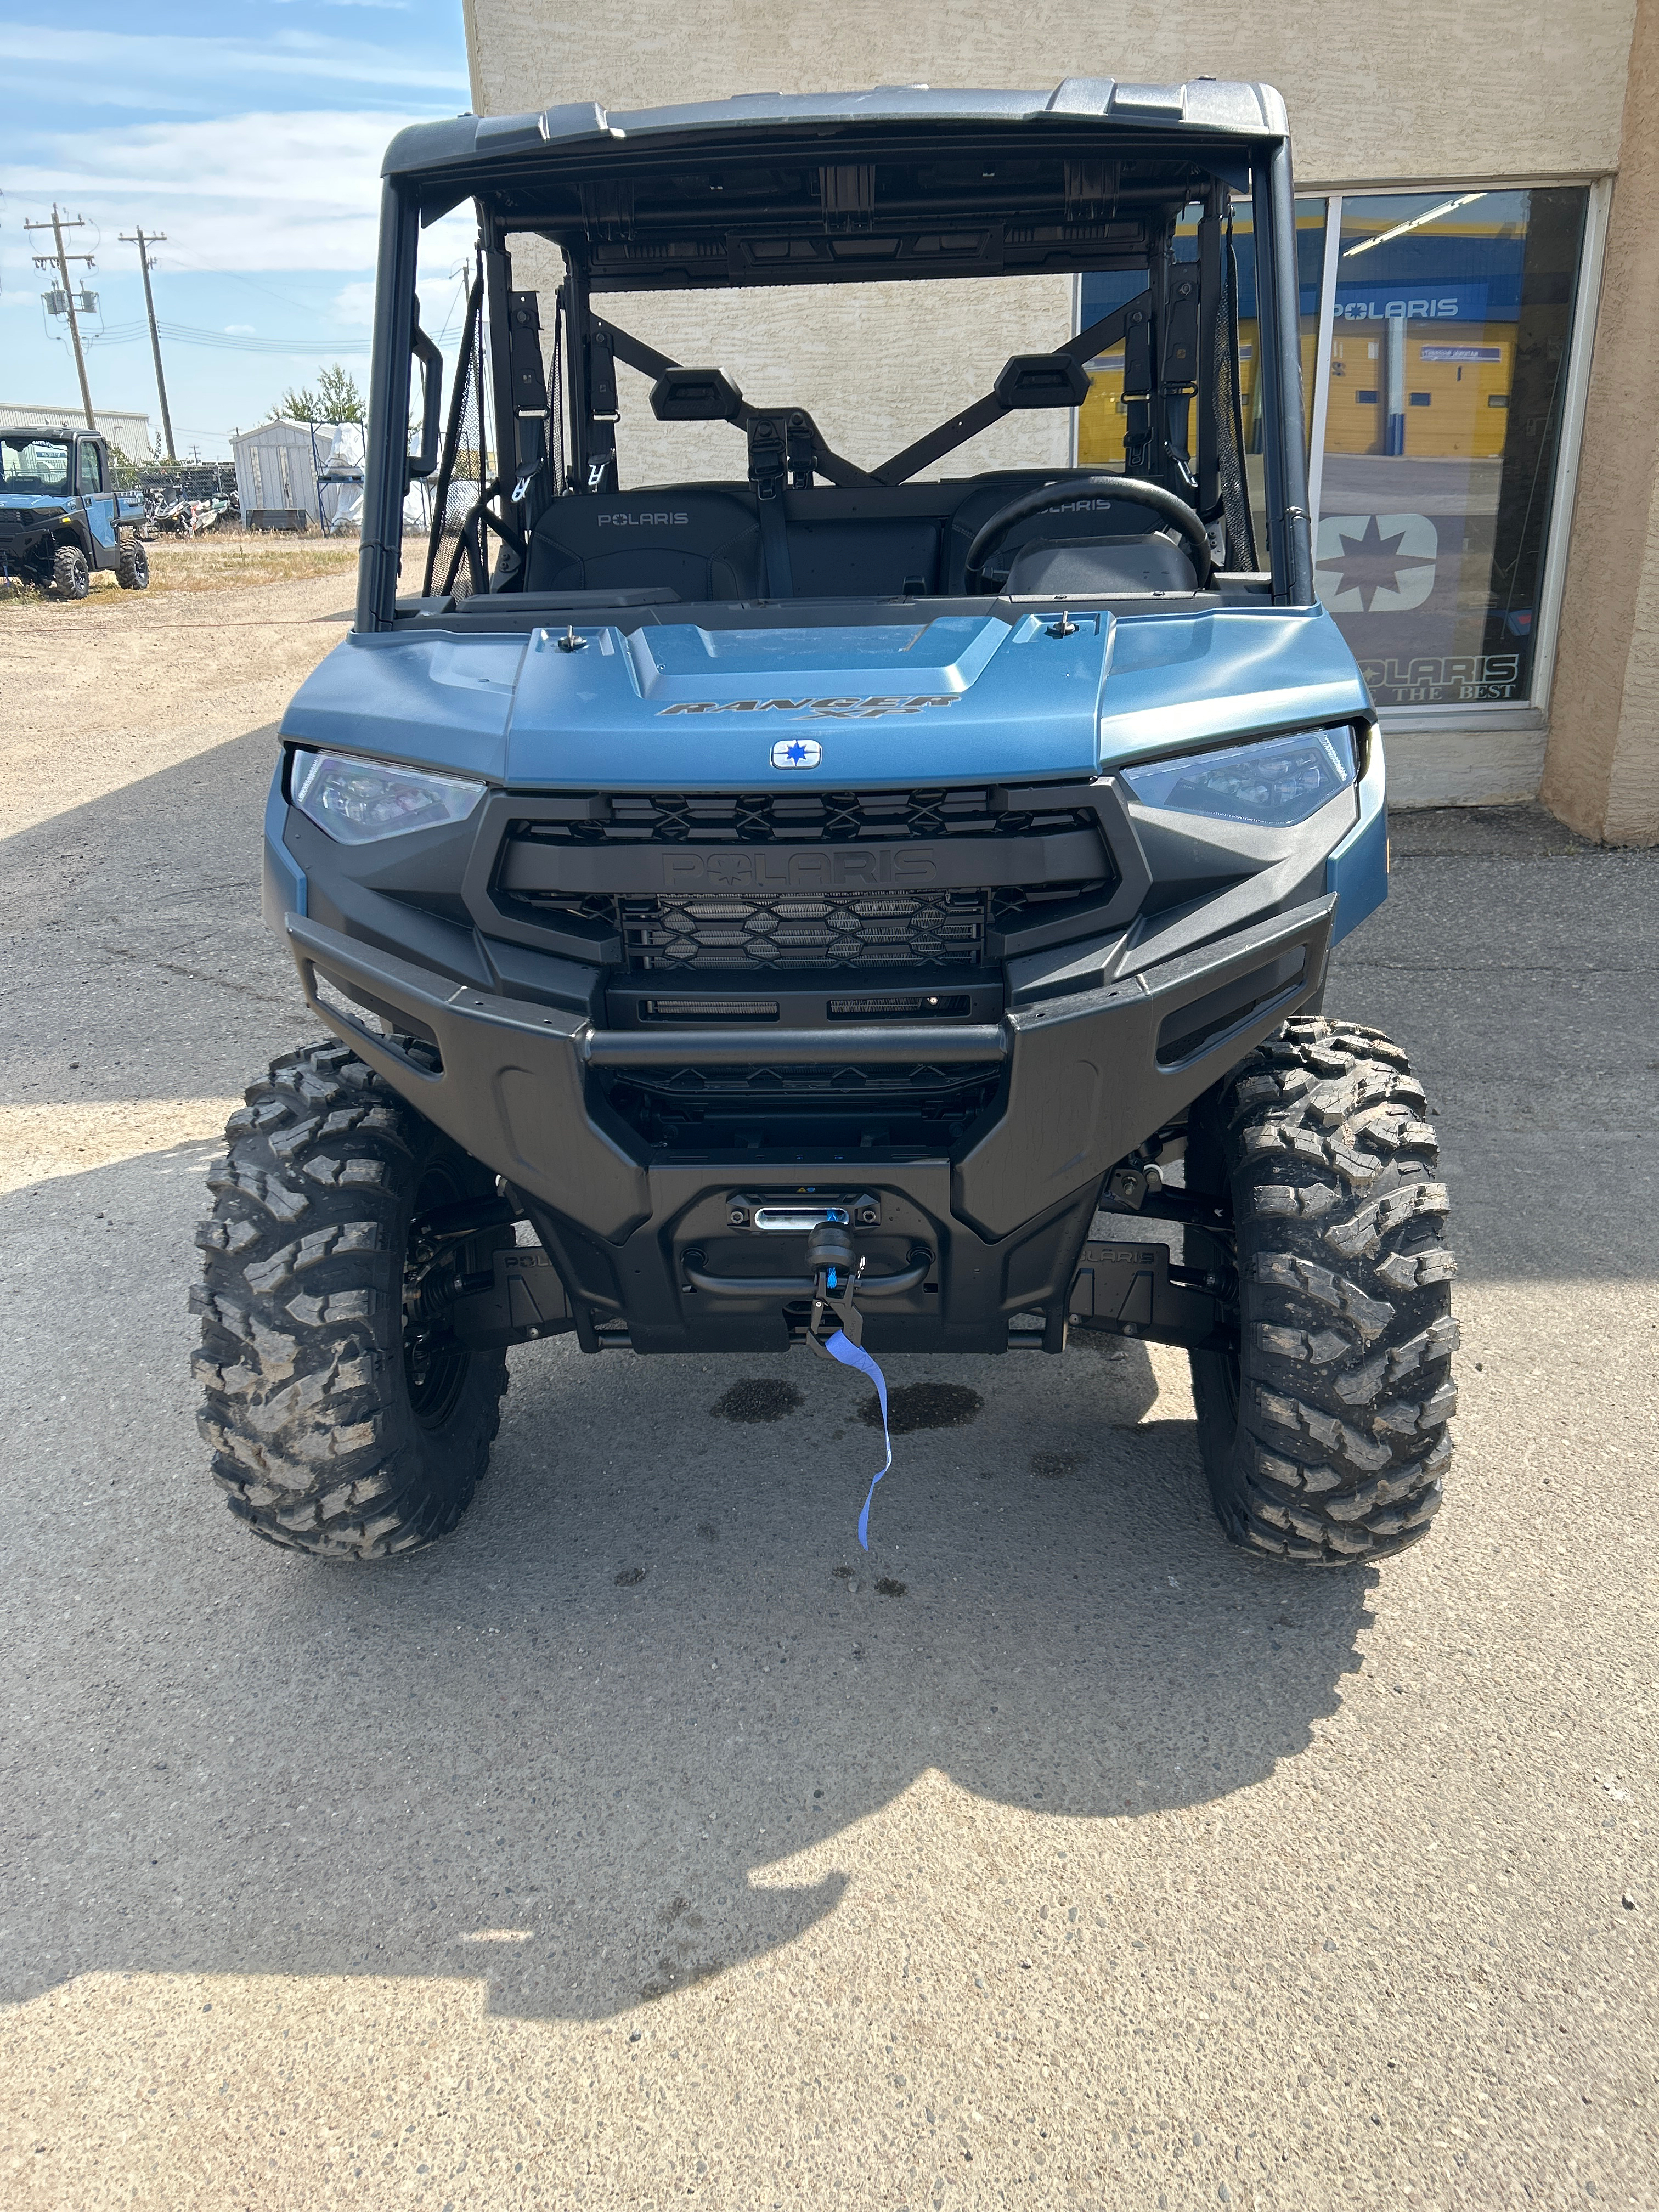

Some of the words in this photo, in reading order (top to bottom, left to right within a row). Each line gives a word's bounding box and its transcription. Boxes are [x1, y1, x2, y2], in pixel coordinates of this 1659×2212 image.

[597, 512, 689, 527] POLARIS
[1358, 654, 1519, 687] OLARIS
[1392, 687, 1443, 702] THE
[1459, 684, 1516, 699] BEST
[656, 695, 962, 716] RANGER
[787, 708, 924, 720] XP
[662, 848, 938, 887] POLARIS
